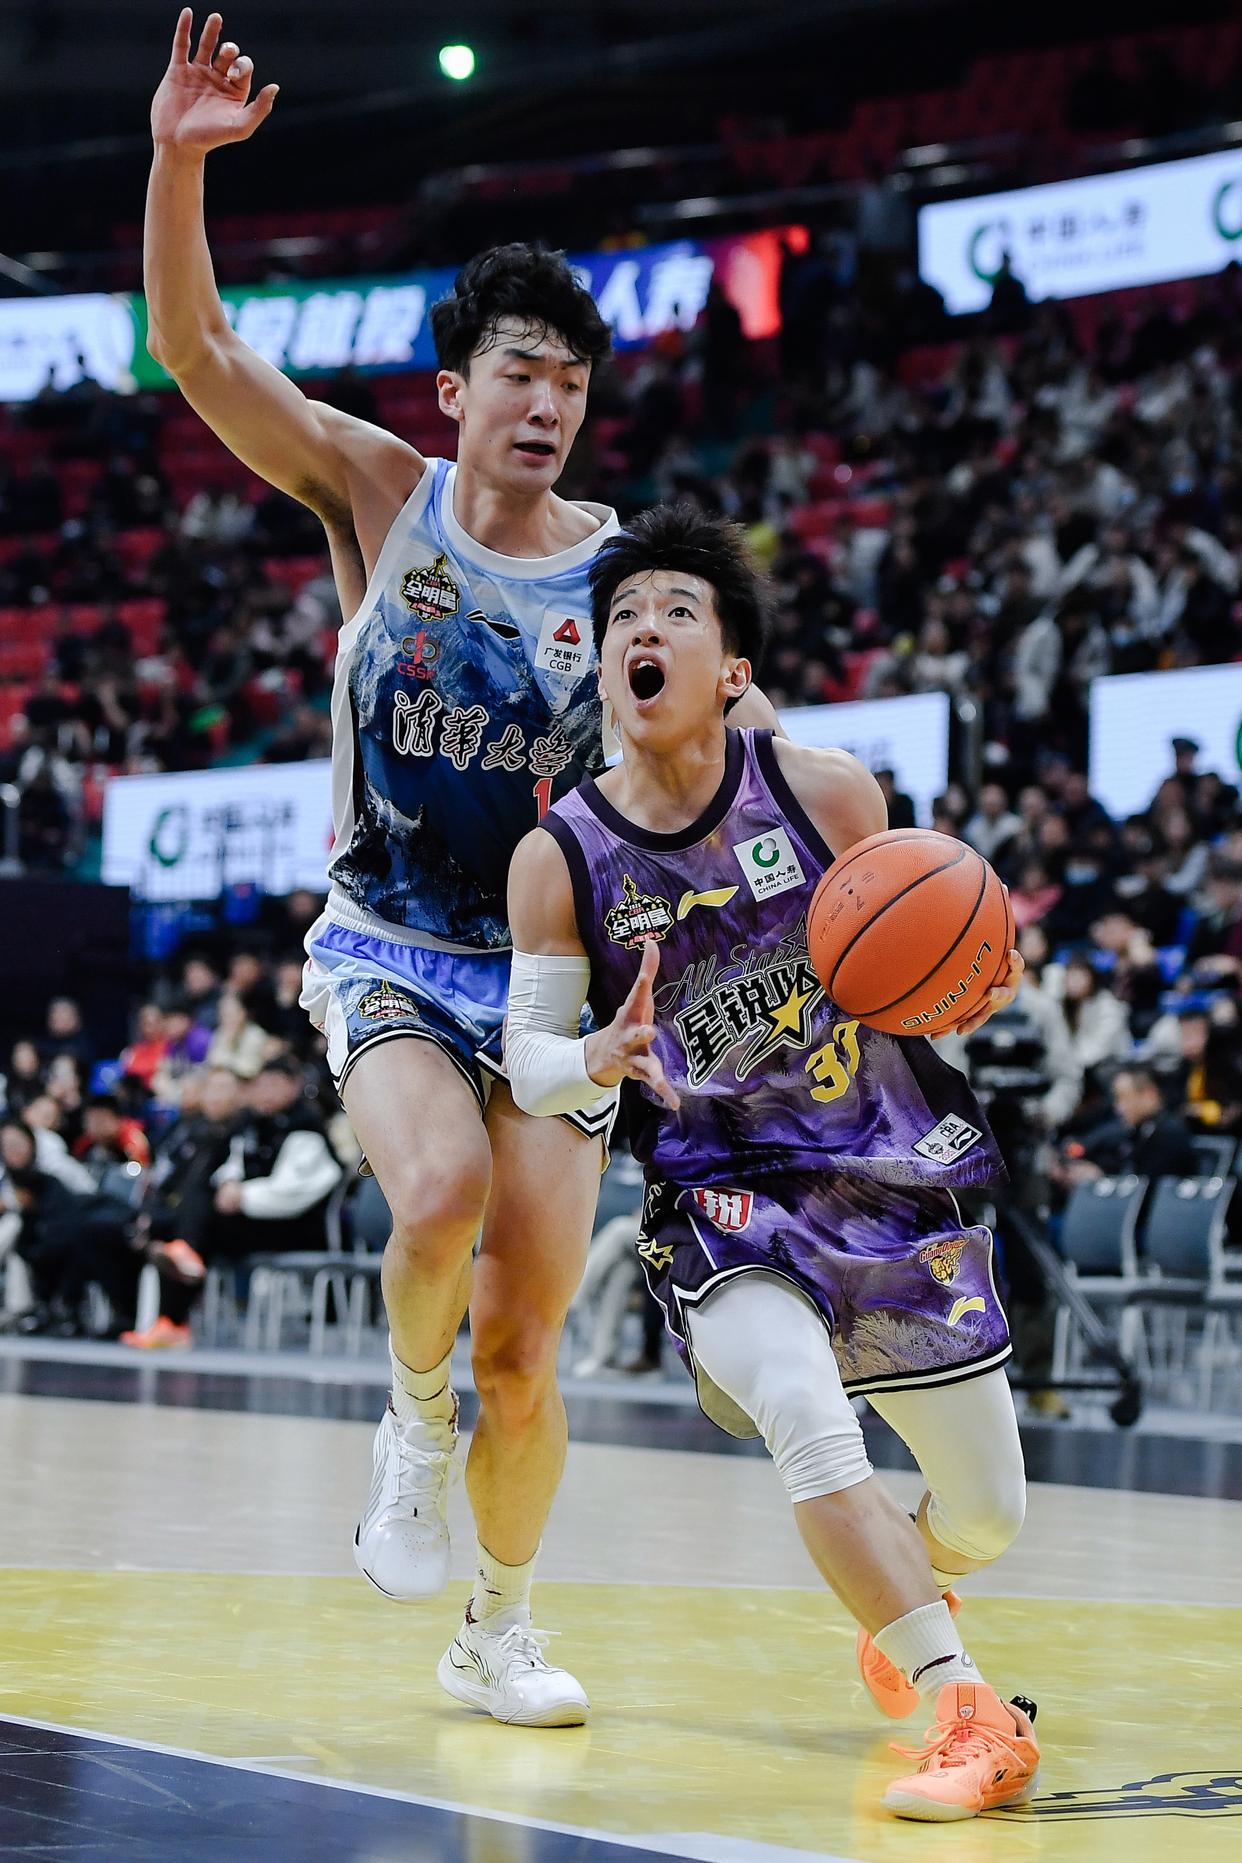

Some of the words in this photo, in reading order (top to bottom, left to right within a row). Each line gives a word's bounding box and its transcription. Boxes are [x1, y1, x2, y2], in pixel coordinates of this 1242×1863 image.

[403, 580, 457, 611] 全明星
[544, 647, 582, 663] 广发银行
[549, 659, 572, 672] CGB
[754, 864, 796, 887] 中国人寿
[757, 881, 782, 894] CHINA
[783, 874, 799, 884] LIFE
[612, 907, 671, 939] 全明星
[901, 939, 993, 1030] LI-NING
[939, 1122, 960, 1138] CBA
